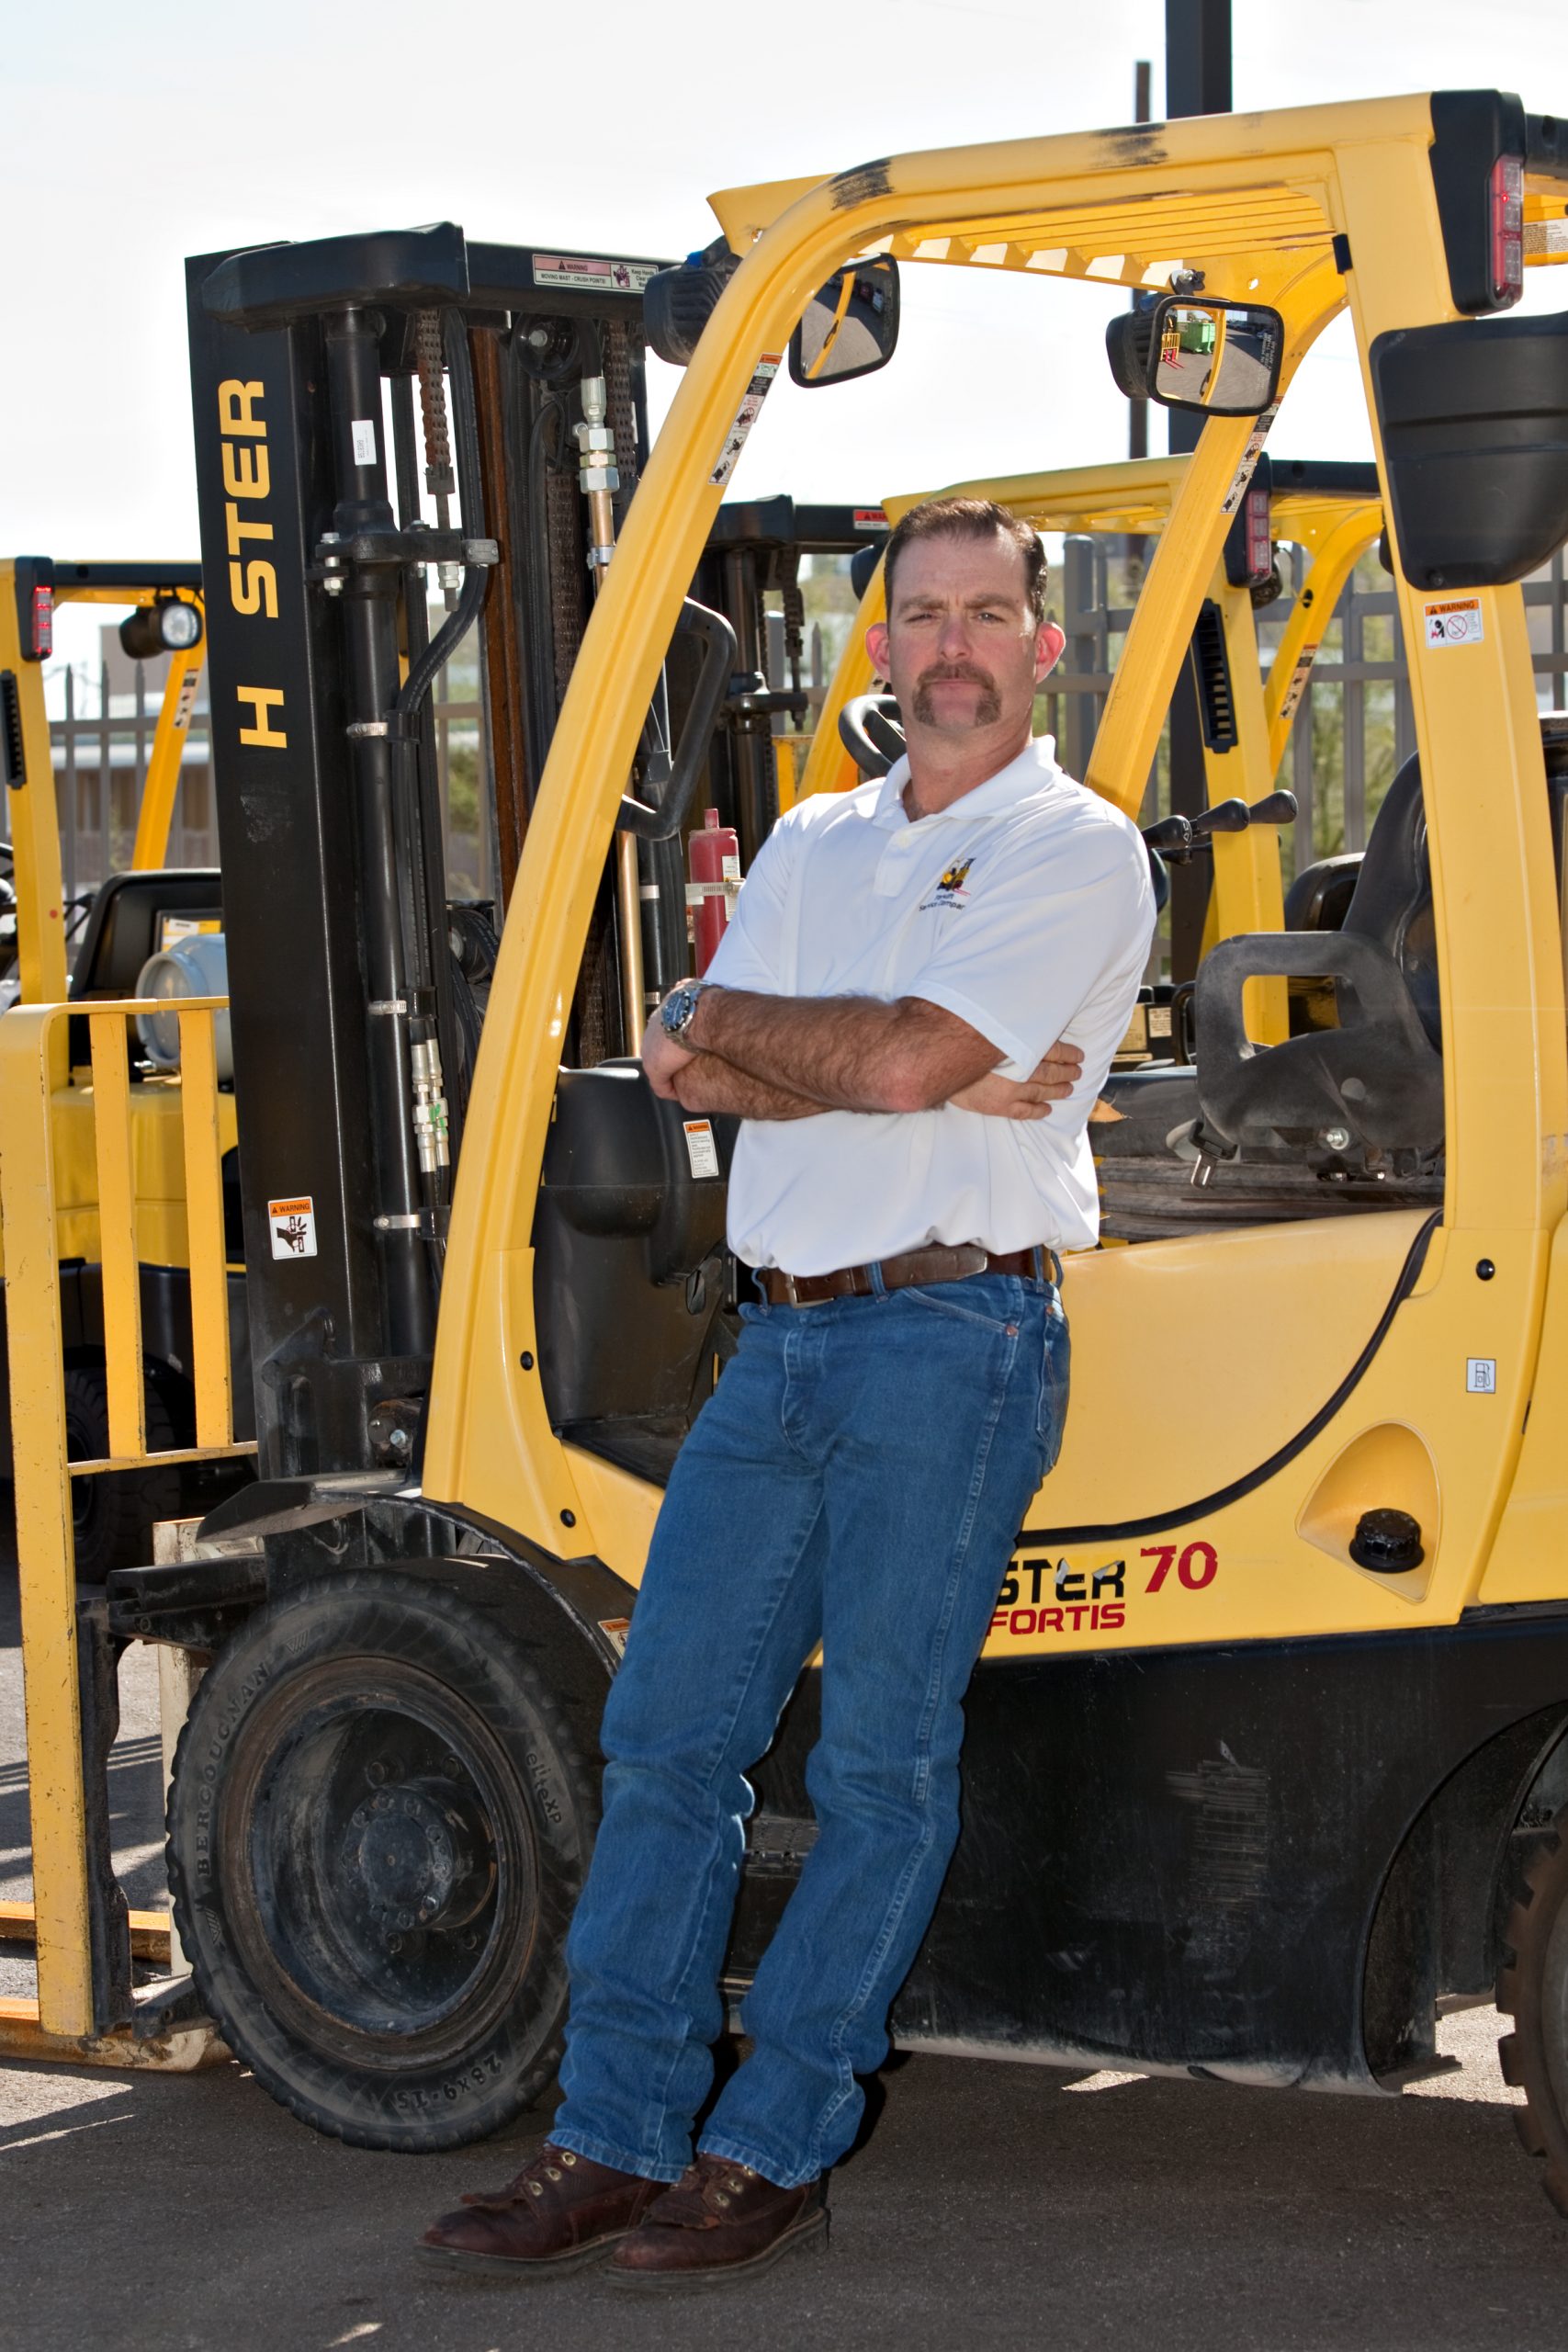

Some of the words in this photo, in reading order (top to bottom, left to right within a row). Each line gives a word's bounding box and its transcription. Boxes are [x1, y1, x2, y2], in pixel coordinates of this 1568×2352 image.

[566, 264, 588, 272] WARNING
[218, 379, 278, 618] STER
[1438, 601, 1475, 613] WARNING
[279, 1203, 310, 1213] WARNING
[1140, 1541, 1218, 1593] 70
[987, 1603, 1126, 1636] FORTIS
